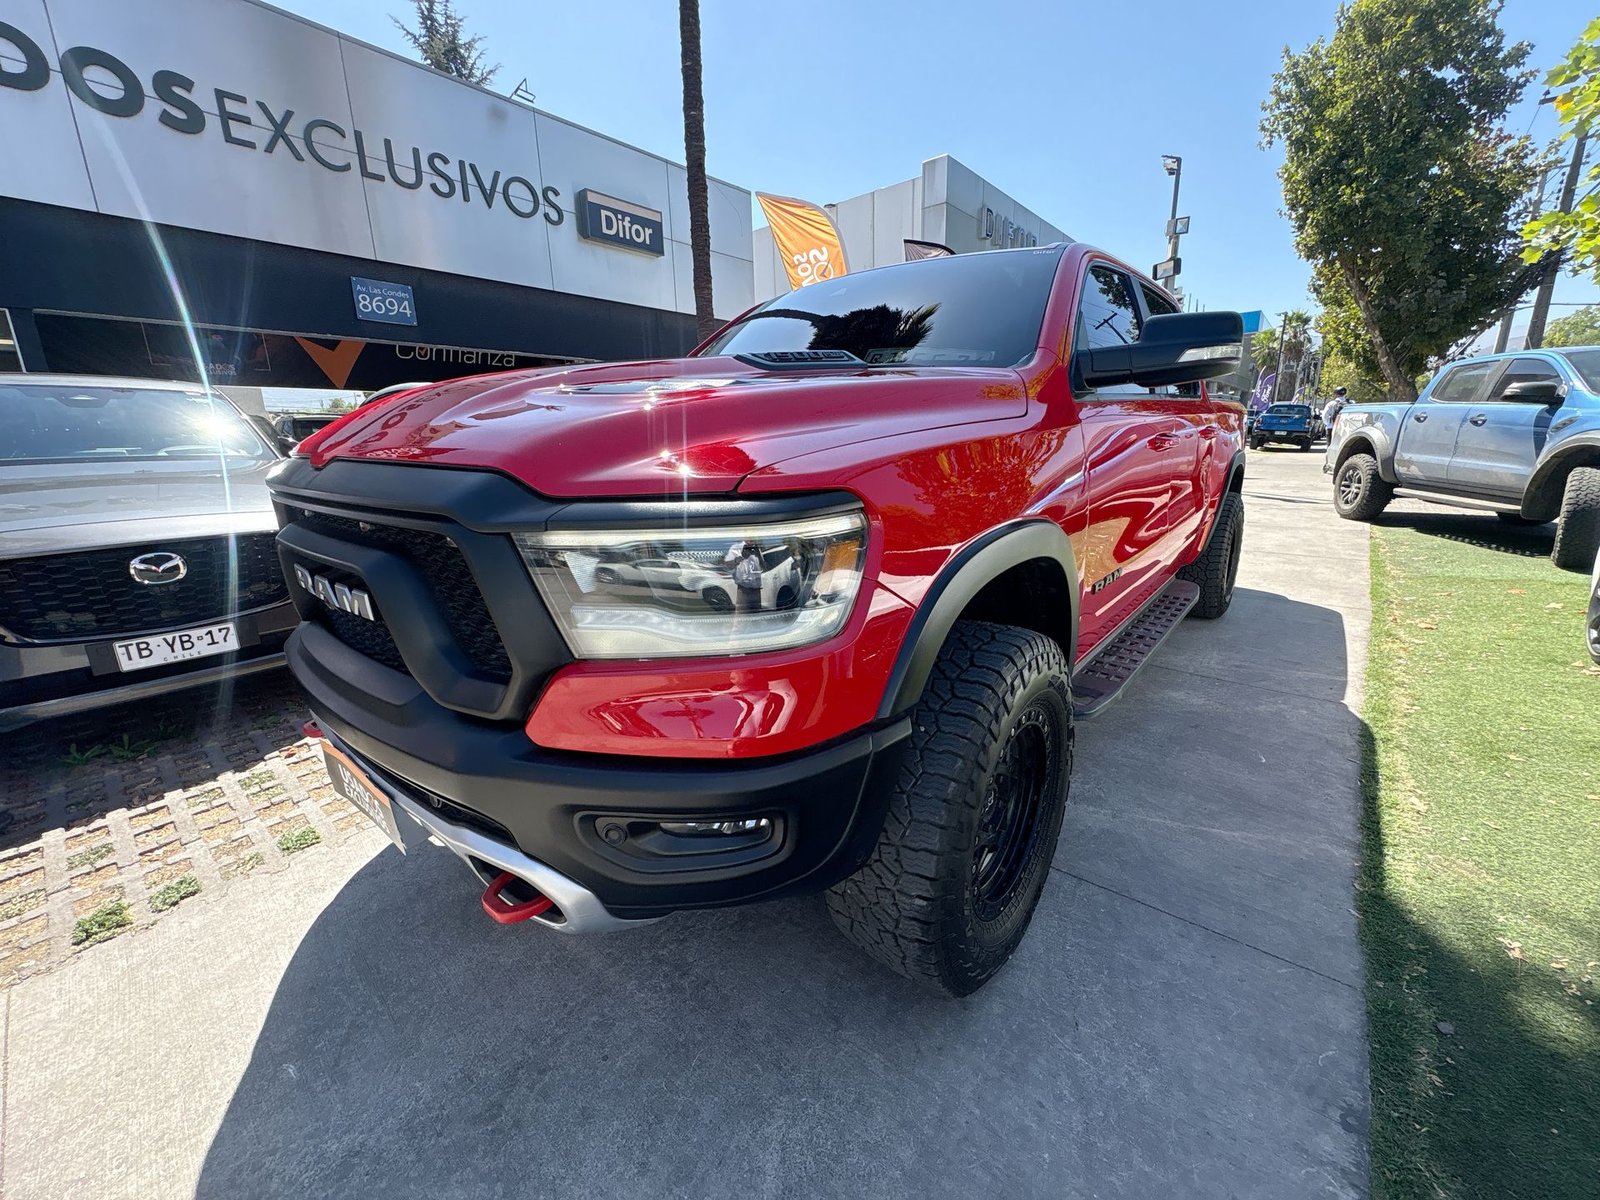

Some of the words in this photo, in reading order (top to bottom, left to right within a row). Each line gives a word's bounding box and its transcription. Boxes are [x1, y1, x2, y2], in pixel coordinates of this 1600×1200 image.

[214, 88, 565, 226] EXCLUSIVOS
[600, 209, 653, 245] Difor
[356, 284, 368, 293] Av.
[369, 286, 381, 294] Las
[382, 288, 409, 299] Condes
[358, 294, 412, 318] 8694
[294, 563, 374, 621] RAM
[1091, 567, 1122, 595] RAM
[163, 650, 201, 662] CHILE
